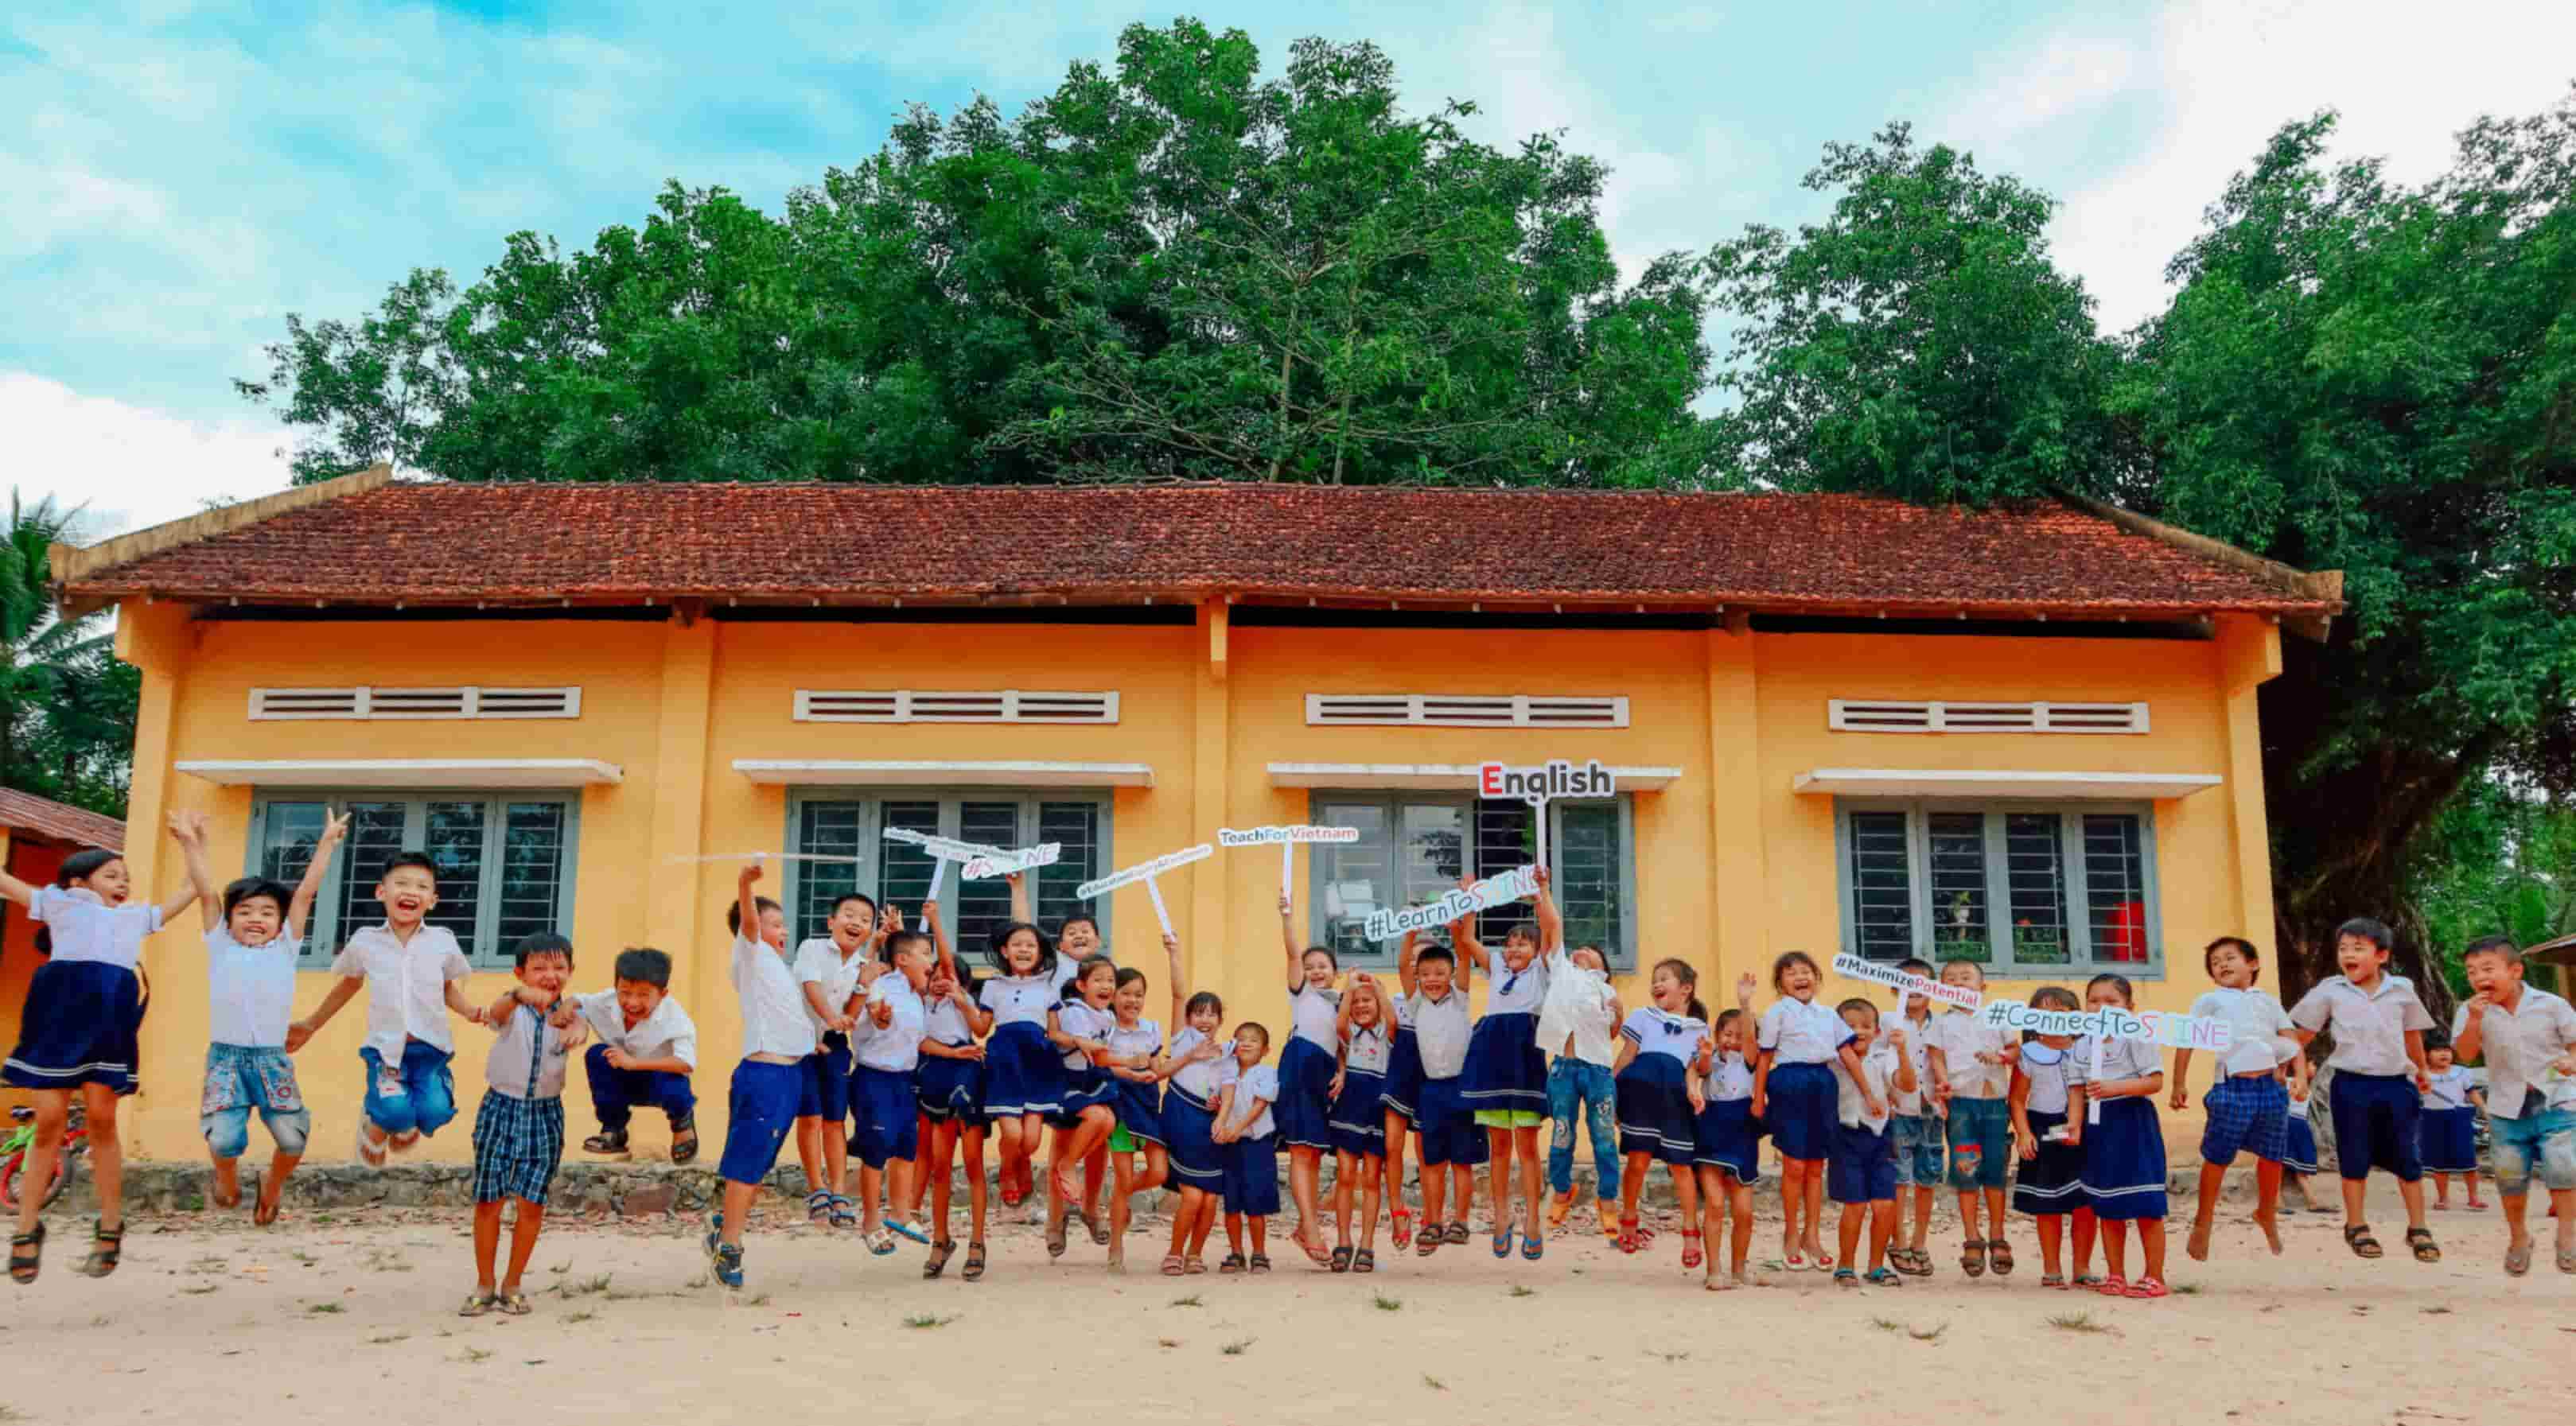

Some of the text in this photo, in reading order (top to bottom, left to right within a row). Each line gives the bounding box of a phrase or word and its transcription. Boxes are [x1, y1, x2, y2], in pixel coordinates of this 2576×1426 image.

[1482, 763, 1610, 802] English
[1220, 827, 1356, 843] TeachForVietnam
[1835, 957, 1979, 1006] #MaximizePotential
